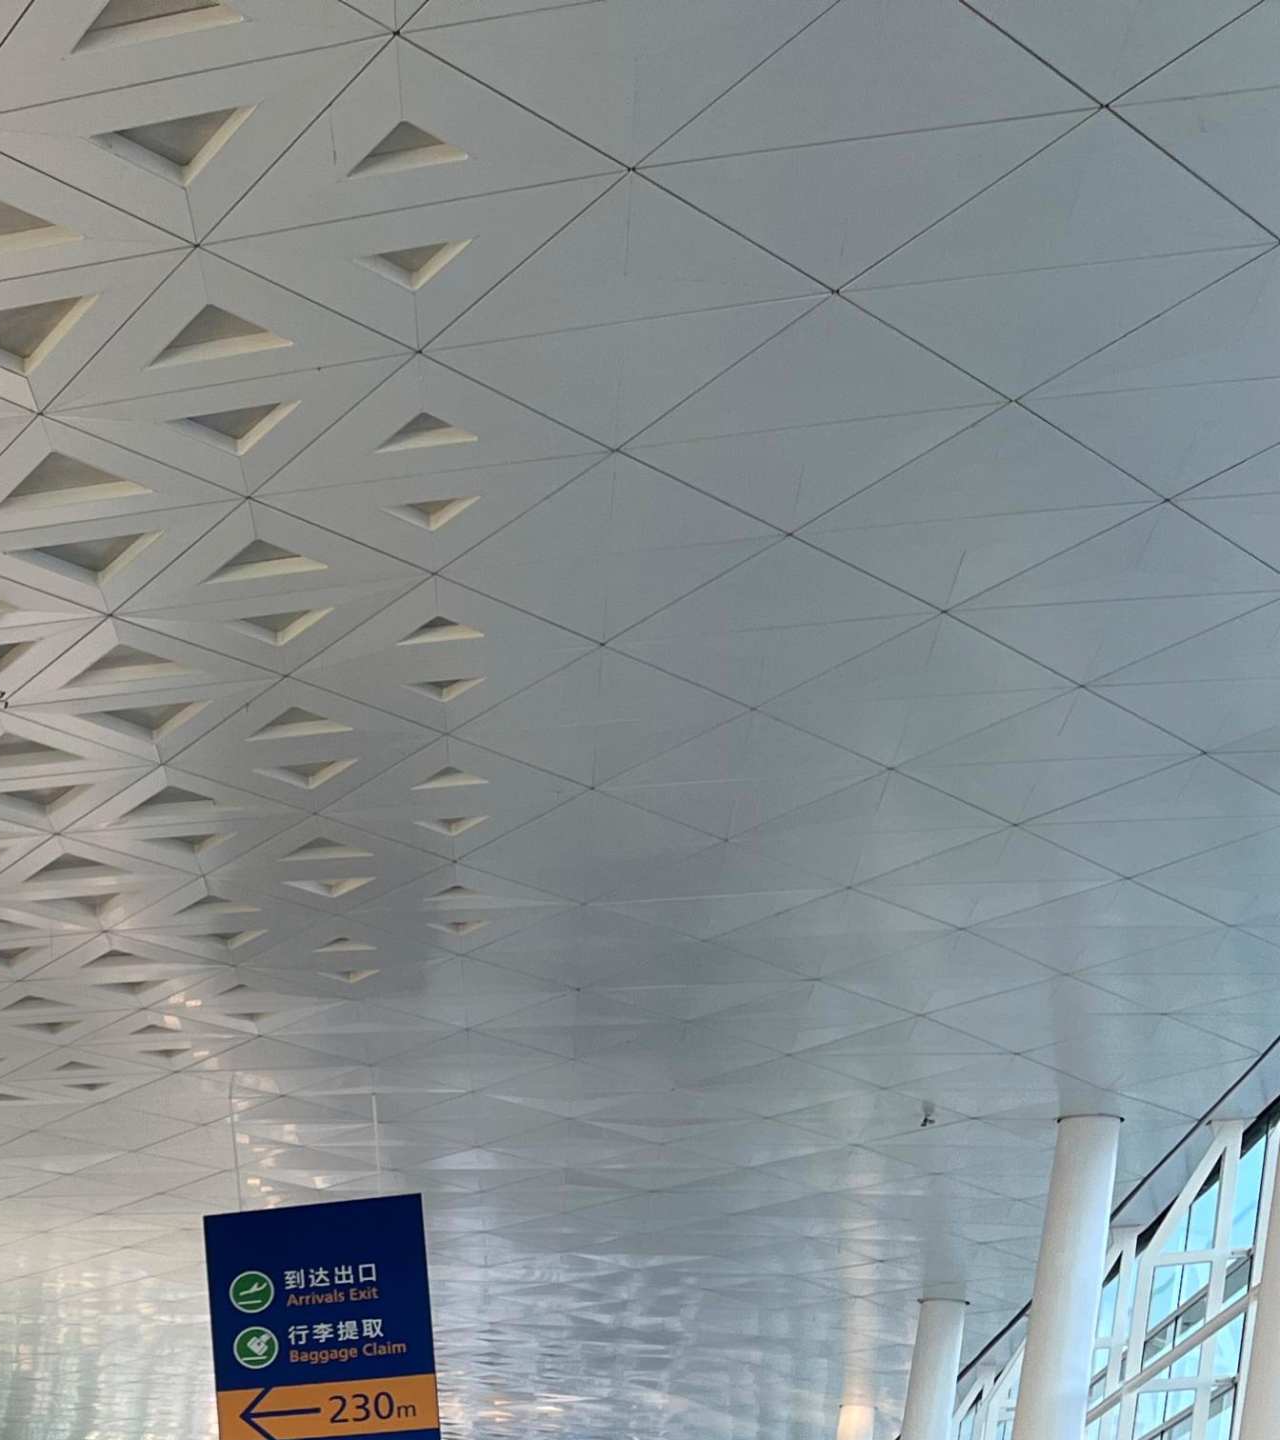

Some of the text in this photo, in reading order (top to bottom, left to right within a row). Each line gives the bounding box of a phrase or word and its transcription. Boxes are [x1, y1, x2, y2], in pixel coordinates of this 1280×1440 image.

[284, 1263, 377, 1290] 到达出口
[287, 1286, 379, 1307] Arrivals Exit
[288, 1318, 384, 1345] 行李提取
[289, 1341, 407, 1364] Baggage Claim
[329, 1391, 416, 1423] 230m
